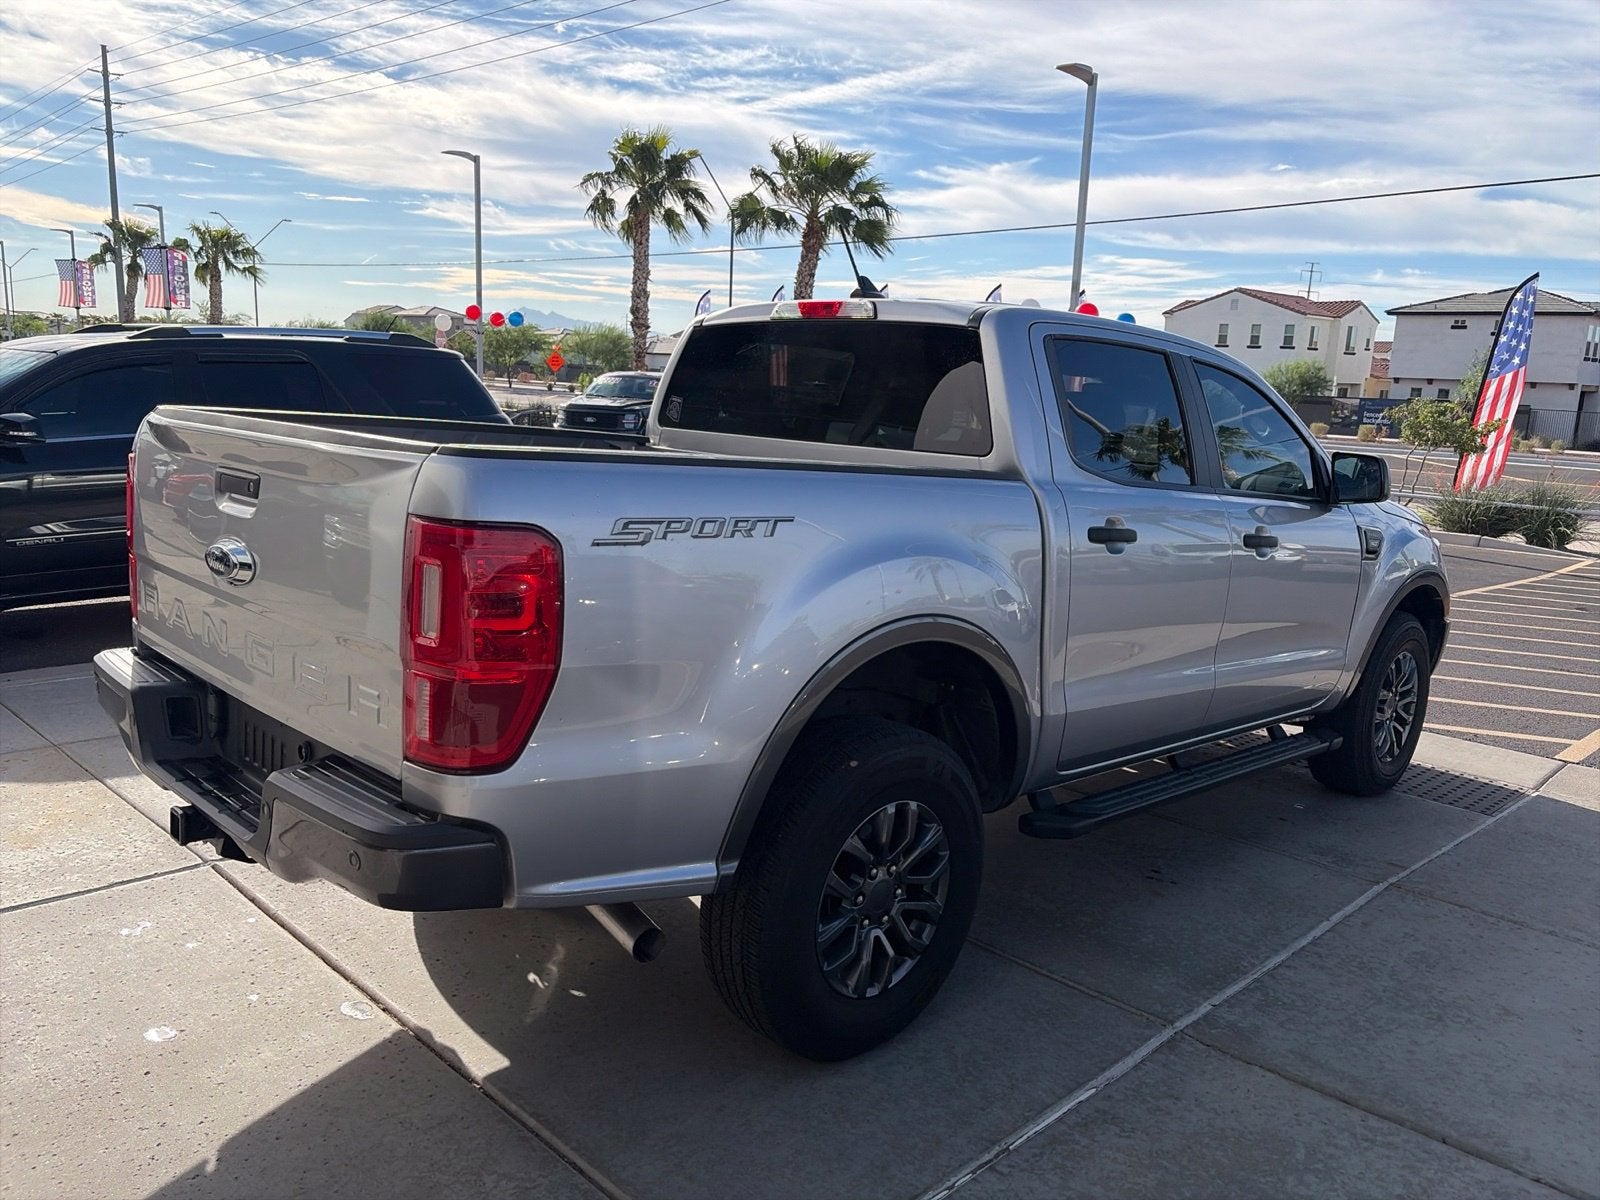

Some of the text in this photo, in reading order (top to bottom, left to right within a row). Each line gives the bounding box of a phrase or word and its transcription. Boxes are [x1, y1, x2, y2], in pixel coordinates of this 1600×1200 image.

[16, 537, 64, 547] DENALI
[591, 516, 795, 547] SPORT
[139, 579, 391, 729] RANGER
